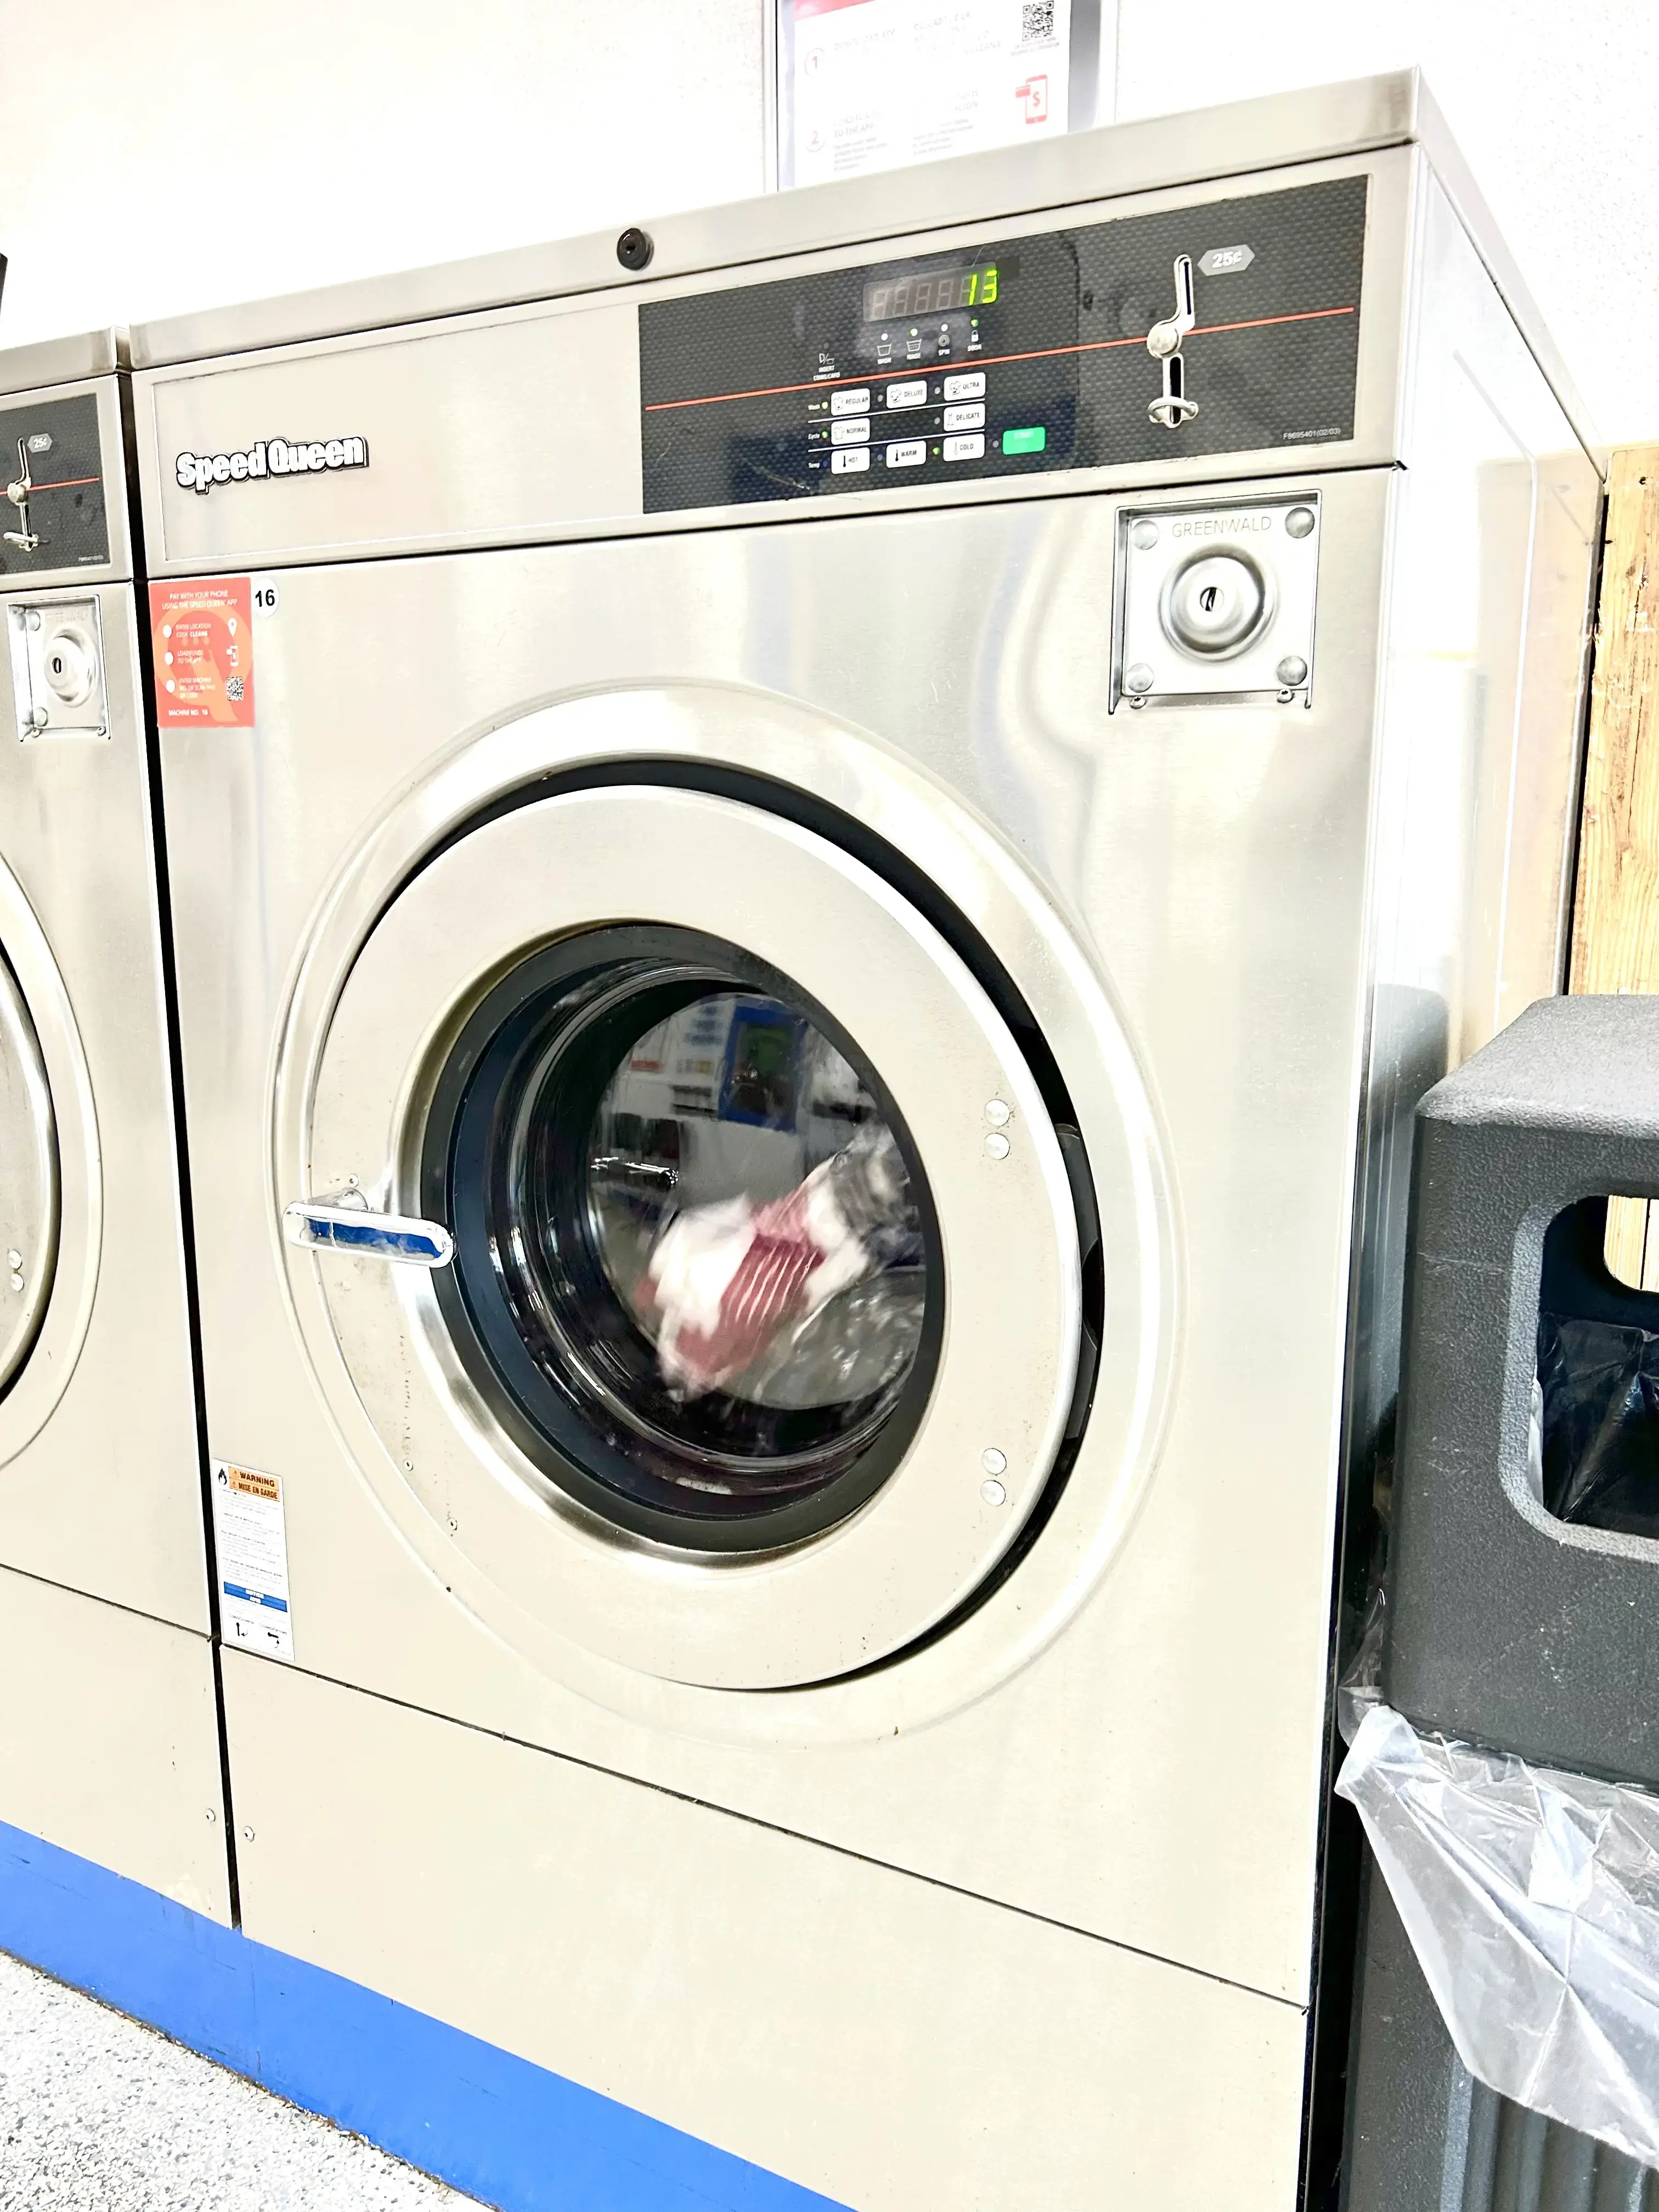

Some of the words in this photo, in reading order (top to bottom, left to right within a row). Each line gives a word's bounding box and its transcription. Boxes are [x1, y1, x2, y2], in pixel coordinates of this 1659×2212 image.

[1211, 250, 1243, 268] 25¢
[968, 269, 999, 306] 13
[963, 381, 980, 390] ULTRA
[904, 388, 924, 398] DELUXE
[845, 396, 869, 405] REGULAR
[956, 411, 980, 421] DELICATE
[846, 426, 867, 435] NORMAL
[900, 449, 917, 458] WARM
[176, 441, 268, 493] Speed
[268, 437, 368, 476] Queen
[1172, 516, 1272, 538] GREENWALD
[194, 591, 209, 599] YOUR
[210, 590, 229, 598] PHONE
[255, 589, 275, 607] 16
[239, 1471, 275, 1487] WARNING
[238, 1482, 251, 1492] MISE
[252, 1486, 259, 1494] EN
[260, 1488, 278, 1499] GARDE
